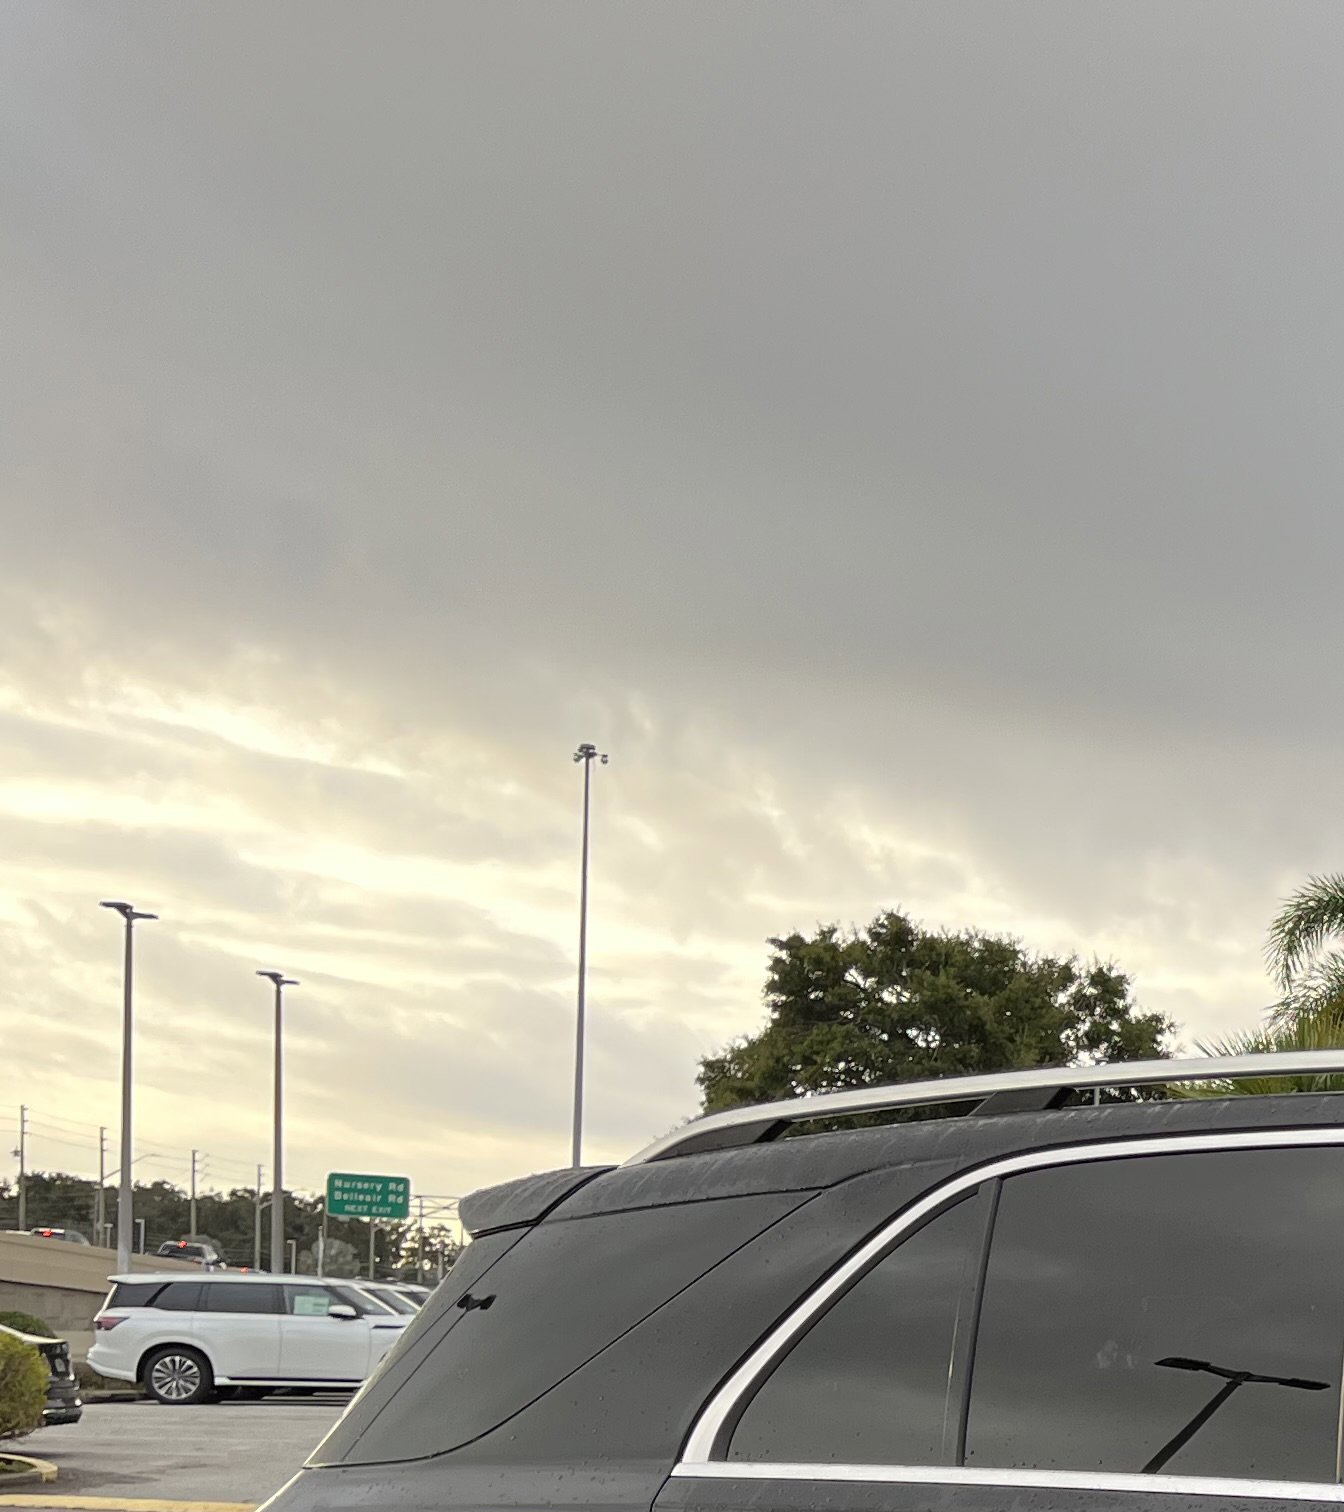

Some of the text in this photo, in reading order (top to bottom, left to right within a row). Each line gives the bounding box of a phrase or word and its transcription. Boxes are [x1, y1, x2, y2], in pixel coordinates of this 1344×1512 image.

[334, 1179, 404, 1192] Nursery Rd
[387, 1194, 404, 1204] Rd
[344, 1204, 392, 1214] NEXT EXIT
